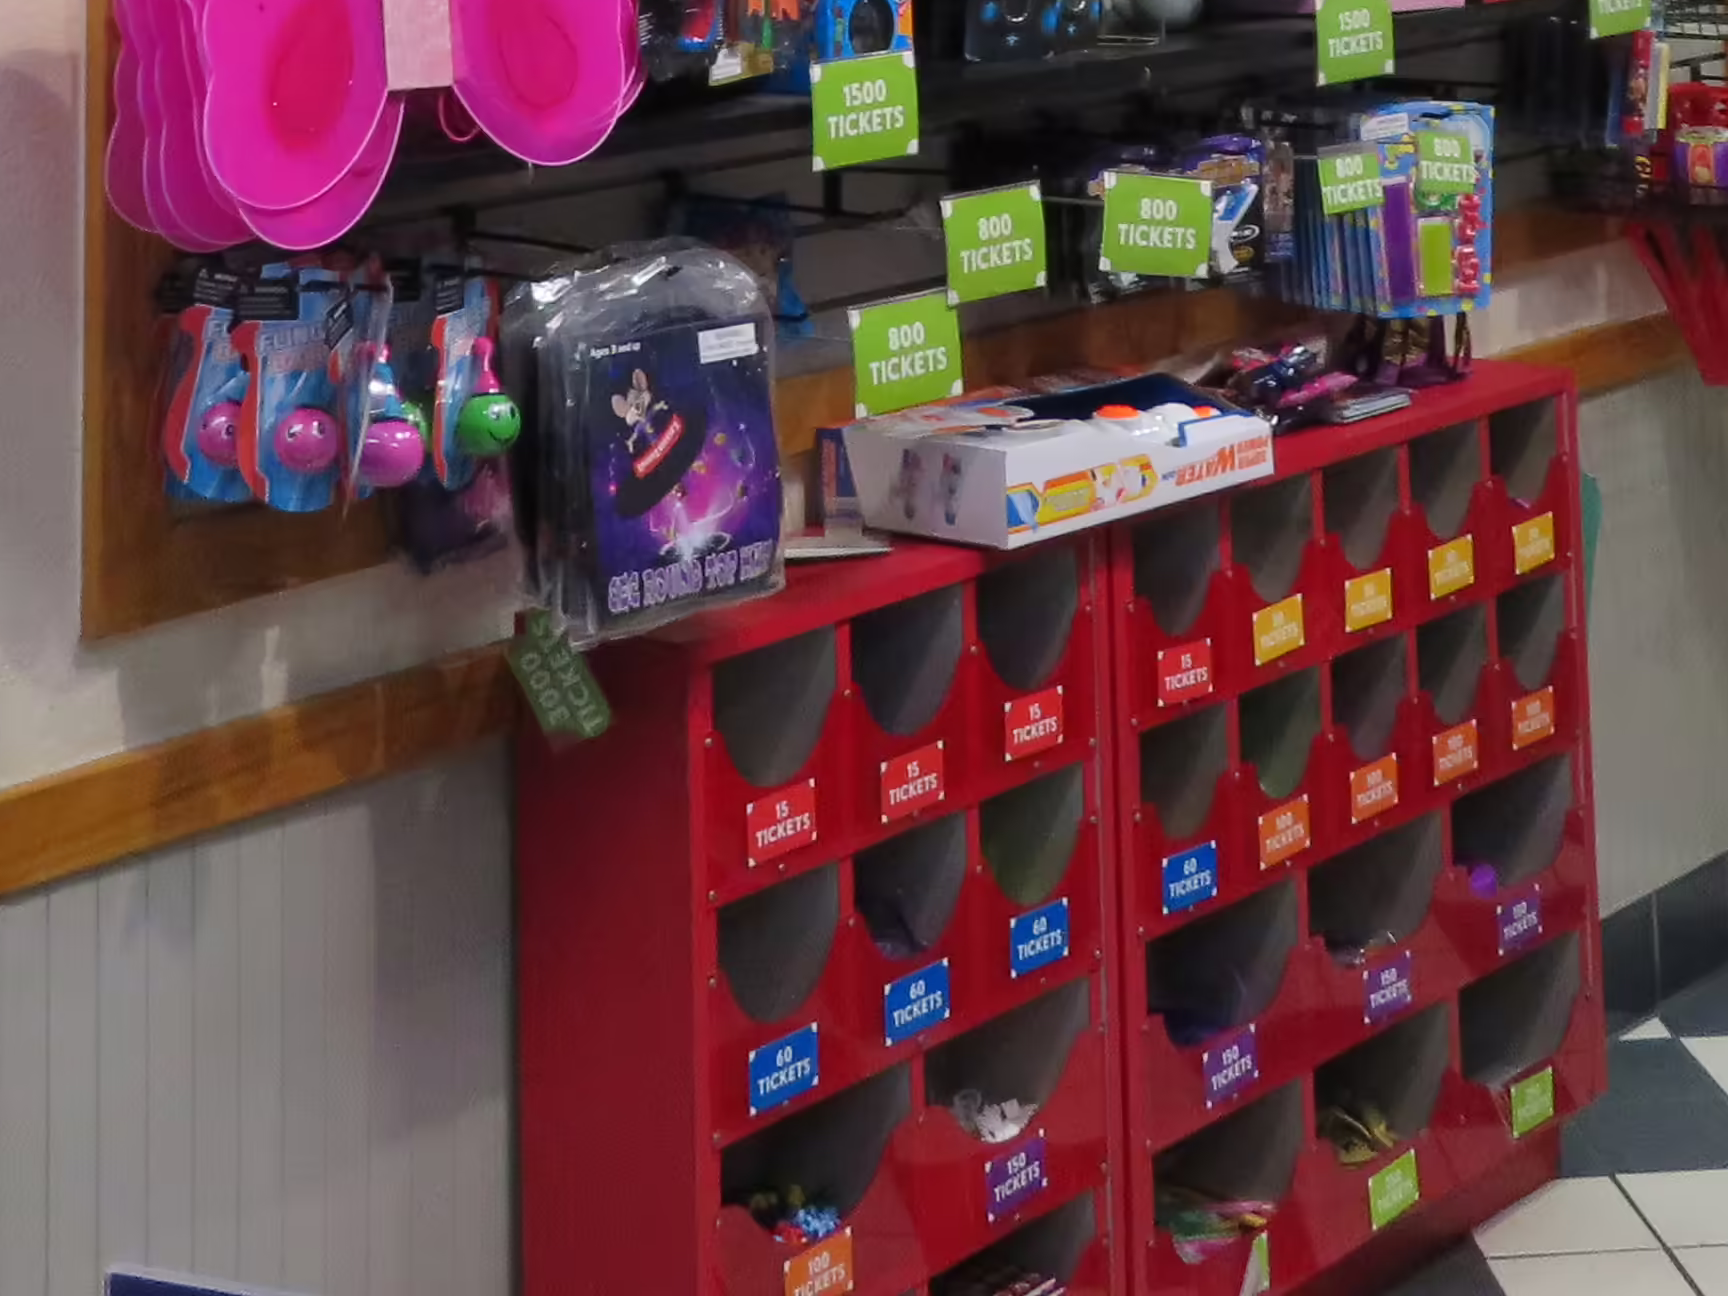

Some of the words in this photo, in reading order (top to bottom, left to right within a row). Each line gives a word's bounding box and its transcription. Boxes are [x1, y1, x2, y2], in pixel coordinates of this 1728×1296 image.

[1339, 8, 1370, 32] 1500
[1328, 28, 1385, 60] TICKETS
[842, 79, 887, 106] 1500
[826, 106, 906, 143] TICKETS
[1432, 137, 1461, 161] 800
[1335, 154, 1364, 179] 800
[1421, 158, 1478, 186] TICKETS
[1321, 177, 1383, 207] TICKETS
[1138, 196, 1178, 222] 800
[977, 212, 1013, 243] 800
[1117, 222, 1197, 251] TICKETS
[959, 238, 1035, 274] TICKETS
[887, 320, 925, 350] 800
[868, 346, 949, 388] TICKETS
[642, 558, 702, 608] ROUND
[1180, 652, 1193, 669] 15
[1164, 665, 1208, 691] TICKETS
[1028, 702, 1042, 720] 15
[1011, 714, 1058, 745] TICKETS
[906, 760, 920, 779] 15
[888, 772, 938, 805] TICKETS
[775, 800, 790, 819] 15
[754, 810, 811, 847] TICKETS
[1265, 822, 1305, 853] TICKETS
[1182, 857, 1198, 875] 60
[1168, 869, 1212, 898] TICKETS
[1032, 915, 1048, 935] 60
[1016, 929, 1063, 961] TICKETS
[908, 979, 926, 1000] 60
[1379, 966, 1398, 988] 150
[1369, 976, 1409, 1010] TICKETS
[892, 990, 944, 1029] TICKETS
[774, 1044, 794, 1068] 60
[1221, 1044, 1240, 1067] 150
[756, 1056, 812, 1097] TICKETS
[1210, 1054, 1253, 1092] TICKETS
[1006, 1151, 1027, 1176] 150
[992, 1161, 1042, 1204] TICKETS
[807, 1250, 831, 1276] 100
[793, 1261, 846, 1296] TICKETS
